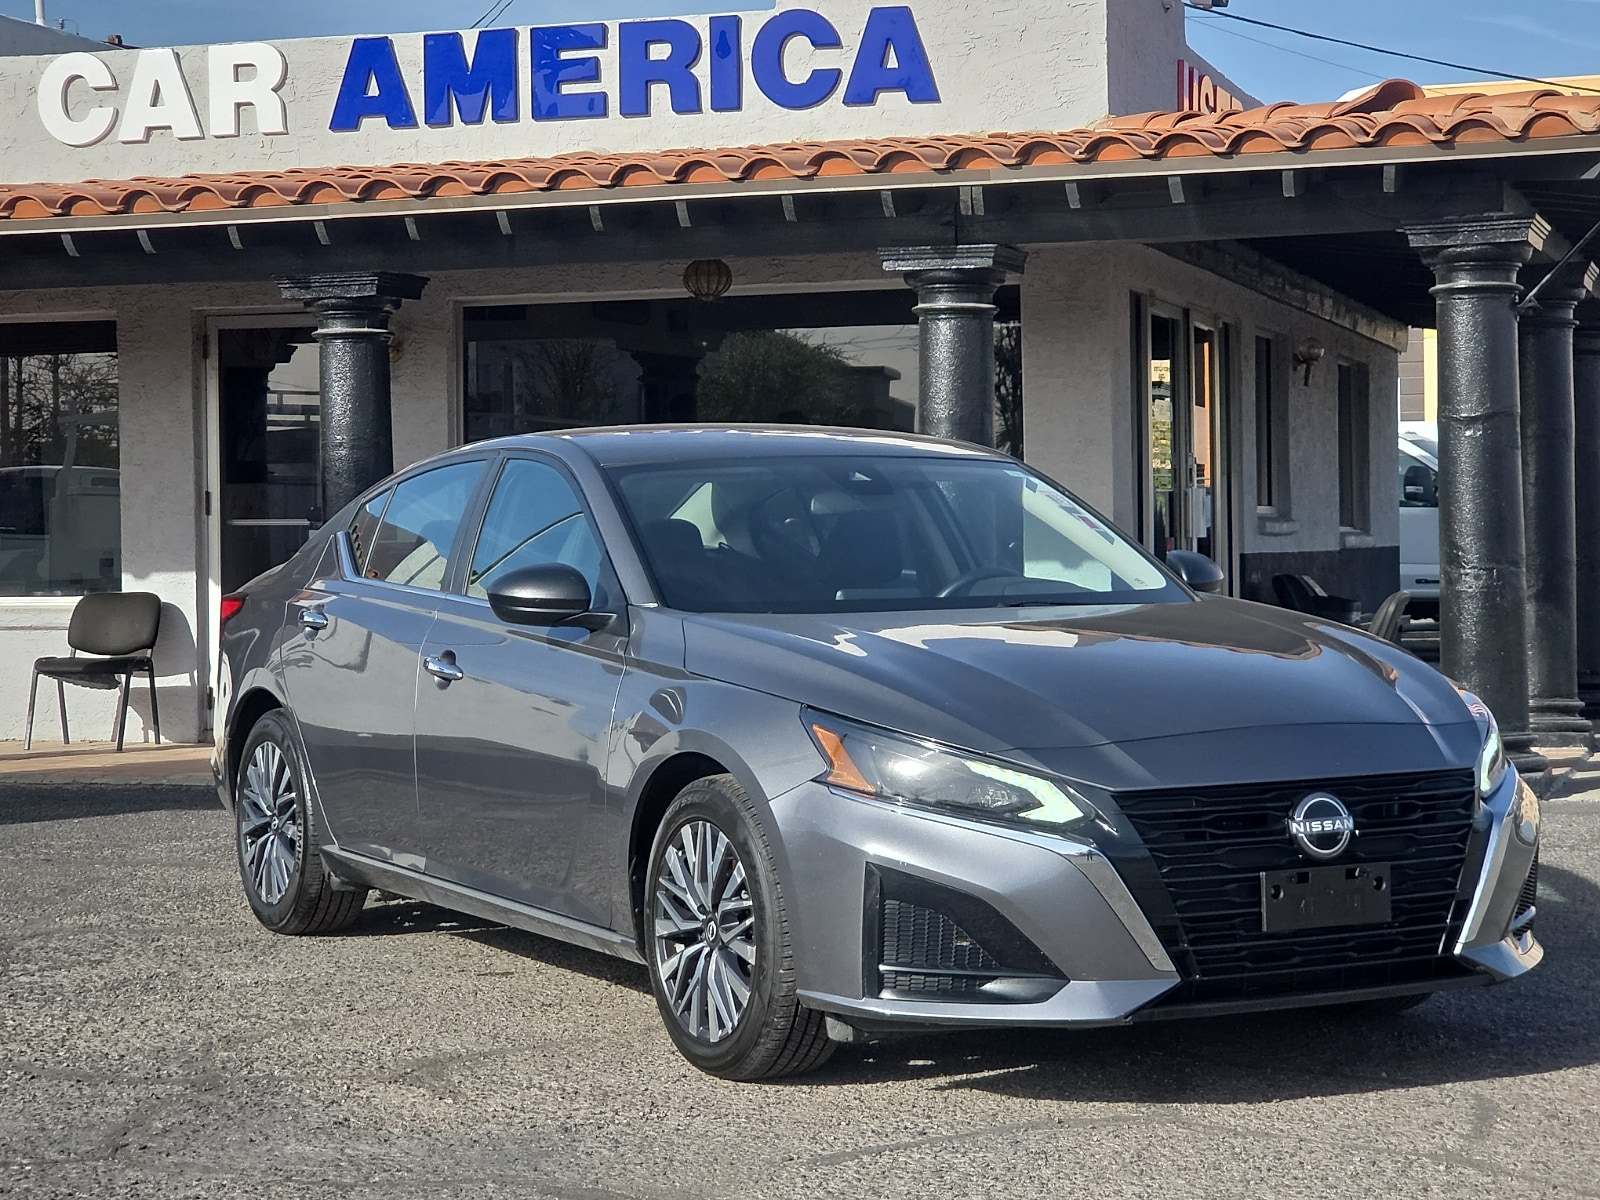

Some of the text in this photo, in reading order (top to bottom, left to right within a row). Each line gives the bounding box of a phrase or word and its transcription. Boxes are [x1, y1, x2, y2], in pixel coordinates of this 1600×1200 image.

[37, 6, 941, 147] CAR AMERICA
[294, 811, 302, 873] KUMHO
[1292, 819, 1353, 833] NISSAN
